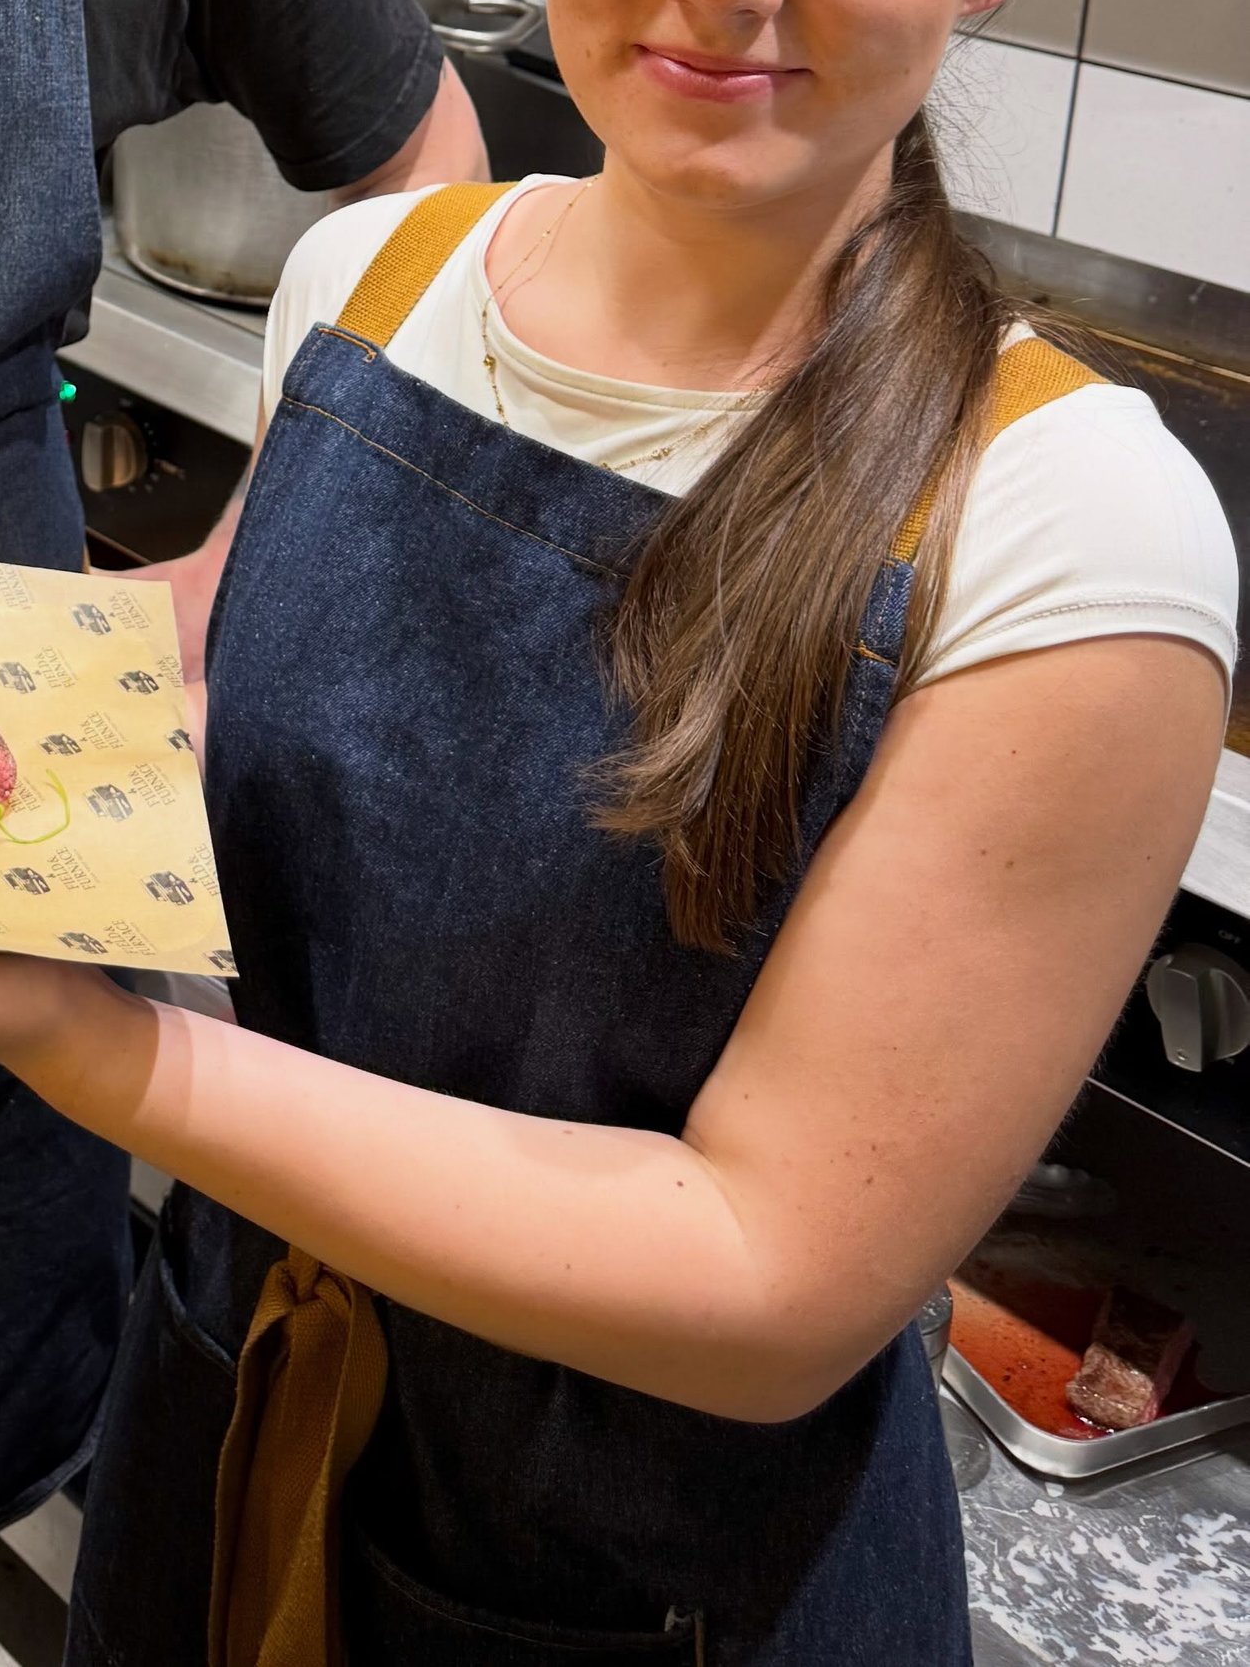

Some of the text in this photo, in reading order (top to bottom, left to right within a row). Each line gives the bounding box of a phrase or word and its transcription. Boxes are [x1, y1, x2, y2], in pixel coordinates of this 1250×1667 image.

[5, 563, 32, 612] FURNAC
[115, 589, 150, 631] FURNACE
[43, 645, 76, 689] FURNACE
[87, 711, 125, 750] FURNACE
[135, 762, 176, 807] FURNACE
[56, 846, 97, 892] FURNACE
